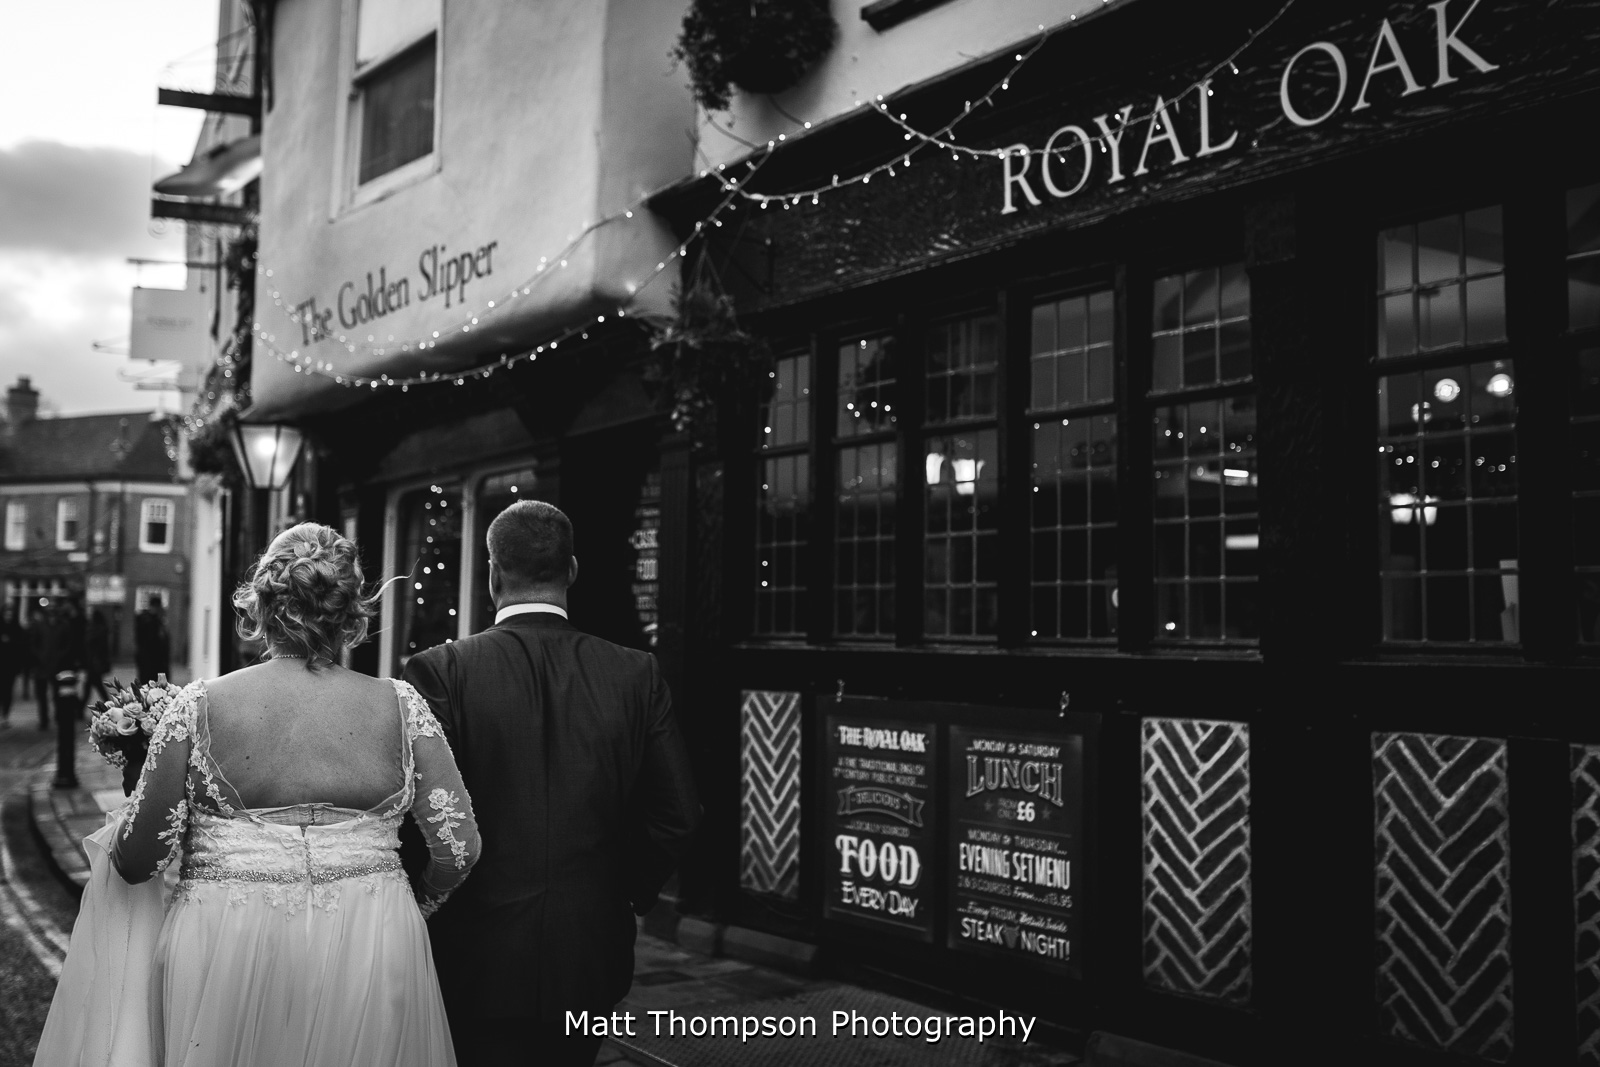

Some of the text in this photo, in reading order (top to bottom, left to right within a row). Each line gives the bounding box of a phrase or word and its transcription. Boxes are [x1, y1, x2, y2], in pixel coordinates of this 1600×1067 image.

[1001, 0, 1499, 215] ROYAL OAK
[296, 241, 498, 346] The Golden Slipper
[838, 725, 926, 753] THE ROYAL OAK
[1018, 743, 1060, 758] SATURDAY
[965, 754, 1064, 808] LUNCH
[1017, 800, 1036, 822] £6
[967, 829, 1001, 843] MONDAY
[835, 834, 921, 886] FOOD
[959, 842, 1071, 890] EVENING SET MENU
[841, 880, 919, 918] EVERY DAY
[960, 916, 1071, 961] STEAK NIGHT!
